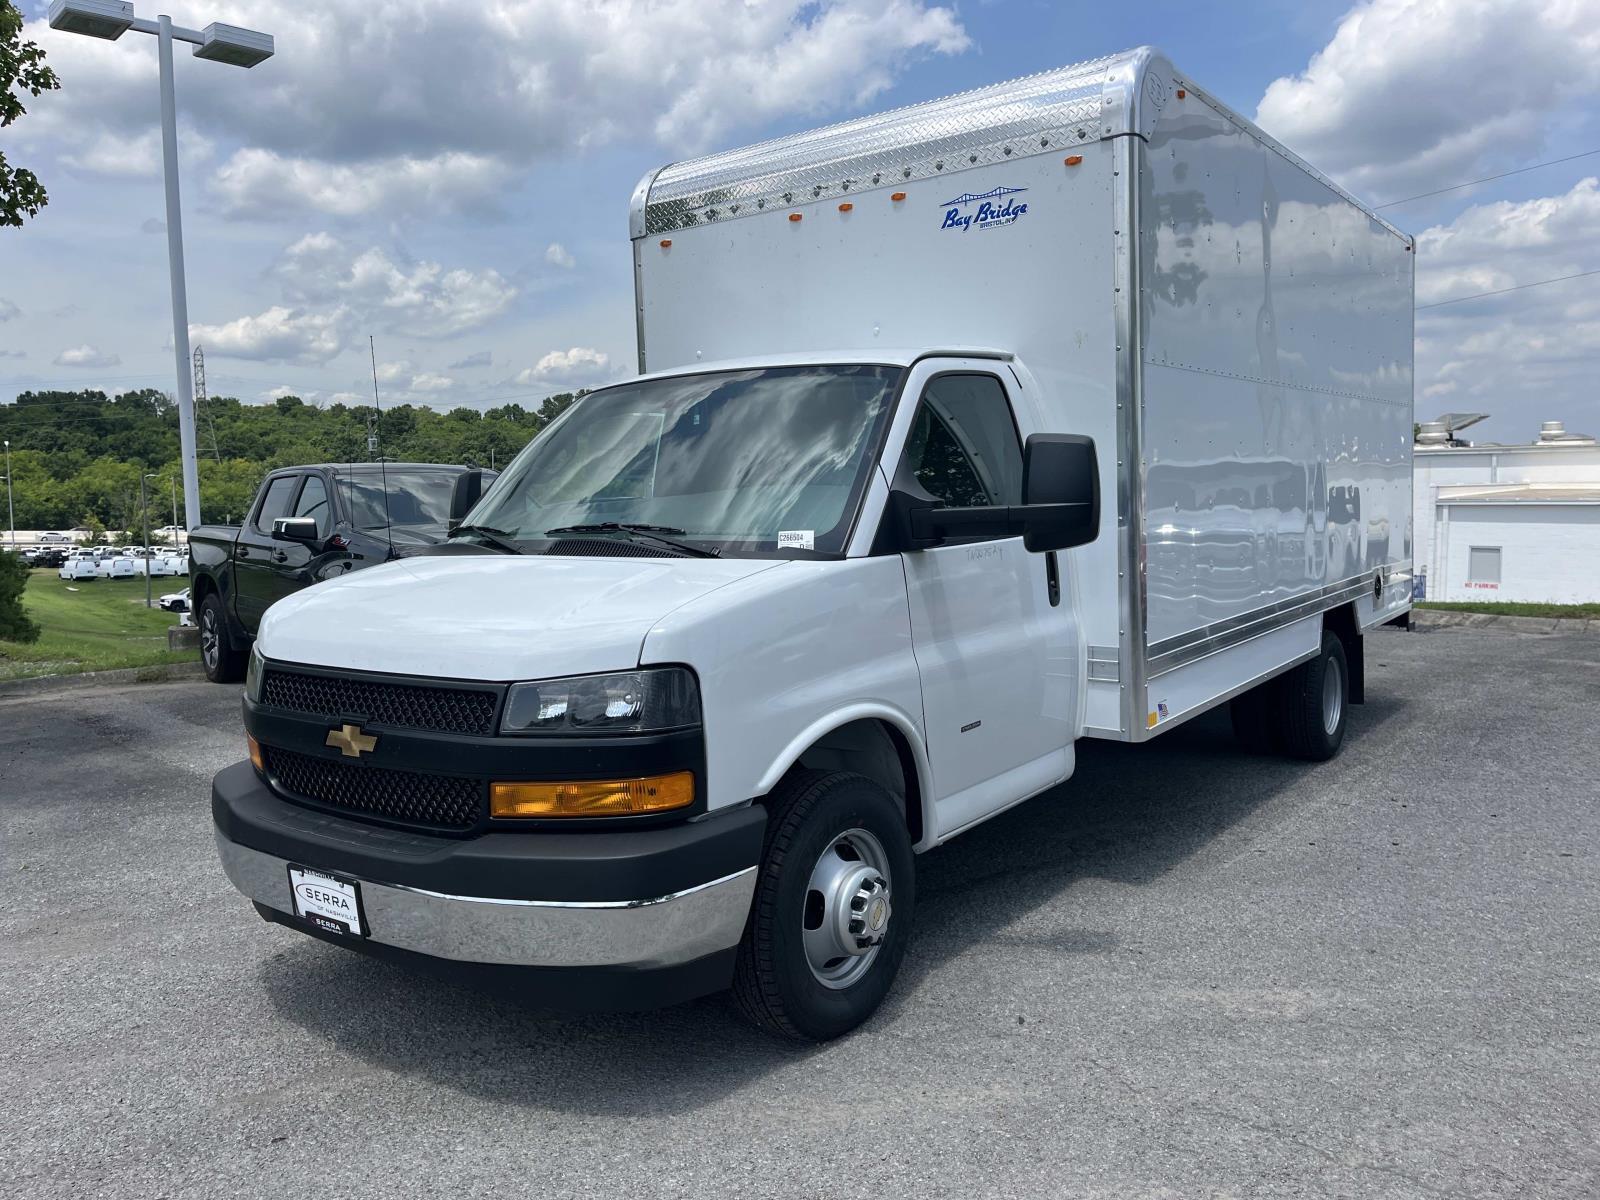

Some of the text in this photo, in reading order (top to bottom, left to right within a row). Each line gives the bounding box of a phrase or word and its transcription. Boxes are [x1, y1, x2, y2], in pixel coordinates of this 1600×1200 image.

[941, 197, 1028, 232] Bay Bridge
[1474, 582, 1499, 590] PARKING
[305, 887, 350, 910] SERRA
[326, 907, 358, 922] NASHVILLE
[315, 918, 341, 931] SERRA
